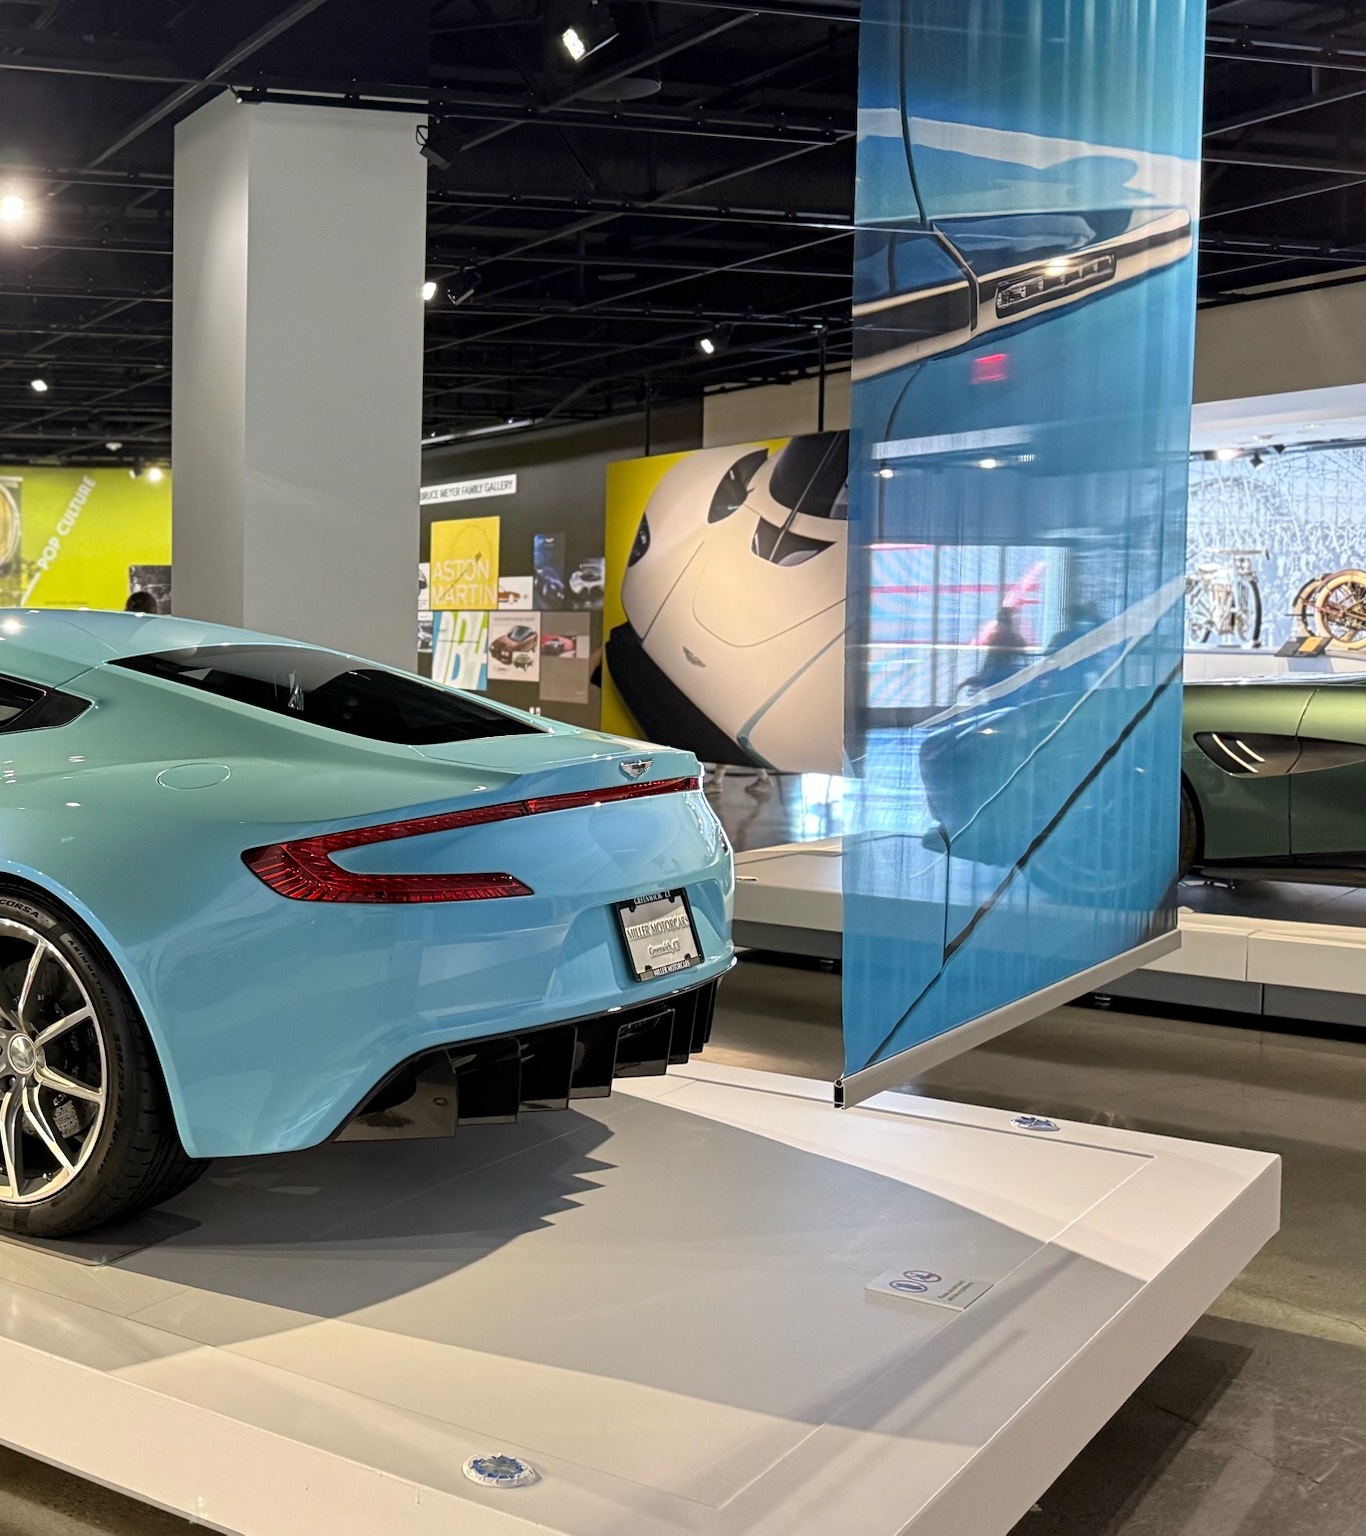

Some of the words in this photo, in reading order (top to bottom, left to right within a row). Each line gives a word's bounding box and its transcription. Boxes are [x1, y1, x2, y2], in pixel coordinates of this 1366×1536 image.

[440, 487, 461, 498] MEYER
[461, 483, 484, 496] FAMILY
[484, 479, 513, 493] GALLERY
[37, 538, 62, 571] POP
[56, 474, 97, 537] CULTURE
[432, 557, 490, 583] ASTON
[431, 583, 497, 606] MARTIN
[627, 925, 651, 940] MILLER
[651, 915, 690, 935] MOTORCARS
